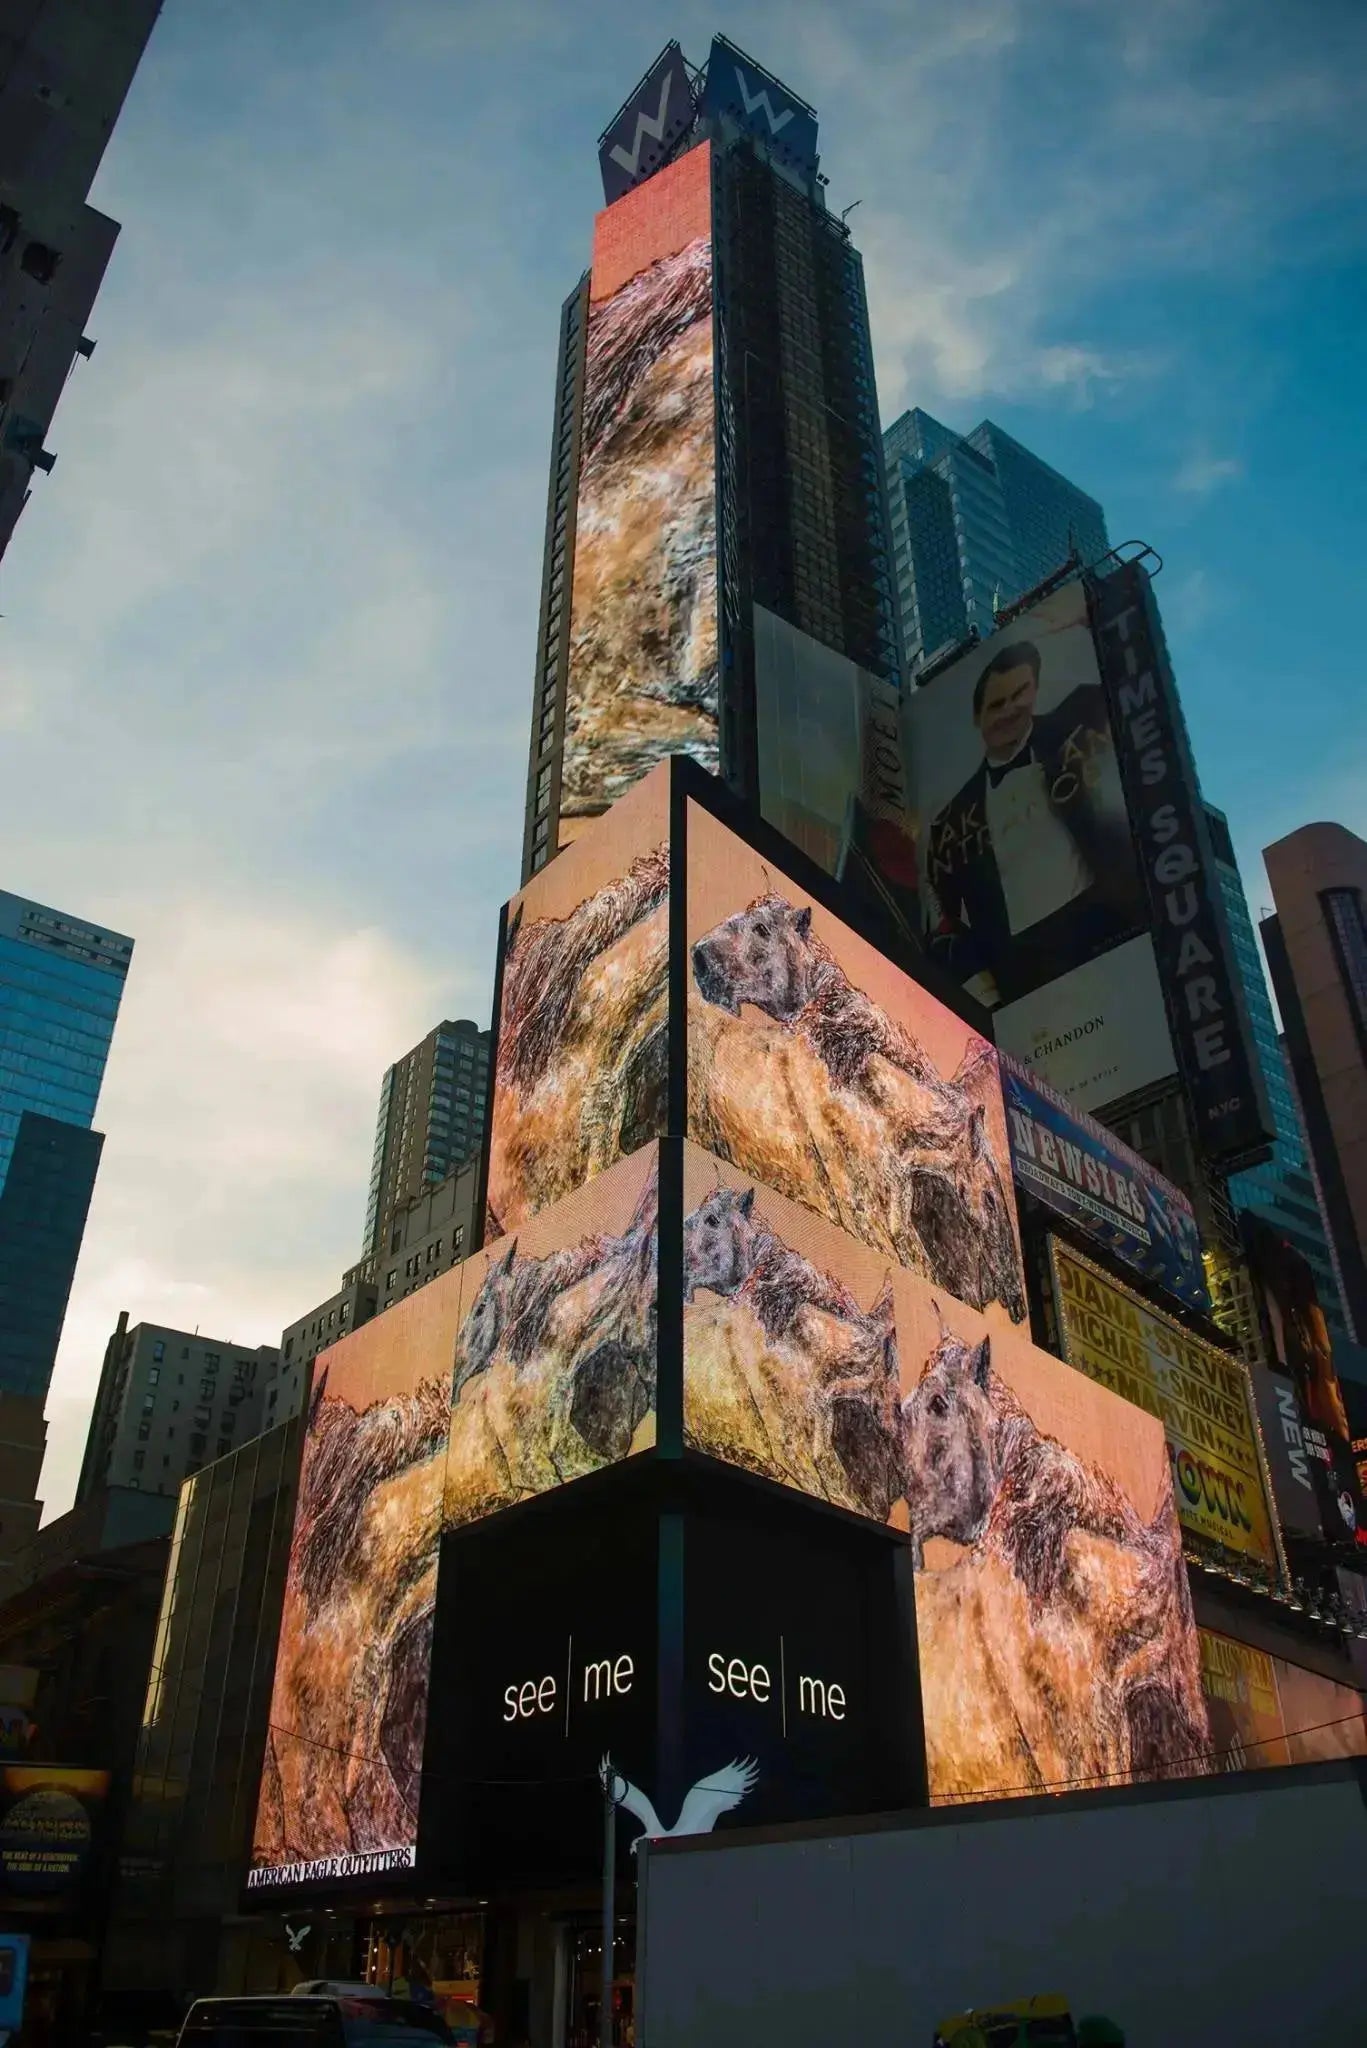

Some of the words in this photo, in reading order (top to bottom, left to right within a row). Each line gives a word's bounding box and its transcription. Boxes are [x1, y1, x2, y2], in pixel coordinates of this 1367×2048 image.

[608, 69, 673, 176] W
[733, 65, 796, 136] W
[1100, 605, 1167, 786] TIMES
[1150, 804, 1232, 1071] SQUARE
[1024, 1055, 1033, 1065] &
[1034, 1015, 1105, 1060] CHANDON
[1207, 1096, 1241, 1121] NYC
[1009, 1107, 1146, 1225] NEWSIES
[1060, 1262, 1142, 1338] DIANA
[1153, 1325, 1244, 1402] STEVIE
[1067, 1303, 1149, 1375] MICHAEL
[1169, 1367, 1247, 1436] SMOKEY
[1273, 1386, 1312, 1490] NEW
[503, 1675, 556, 1722] see
[583, 1653, 634, 1702] me
[708, 1652, 770, 1702] see
[799, 1671, 846, 1720] me
[248, 1864, 301, 1889] AMERICAN
[304, 1858, 337, 1881] EAGLE
[340, 1848, 411, 1877] OUTFITTERS
